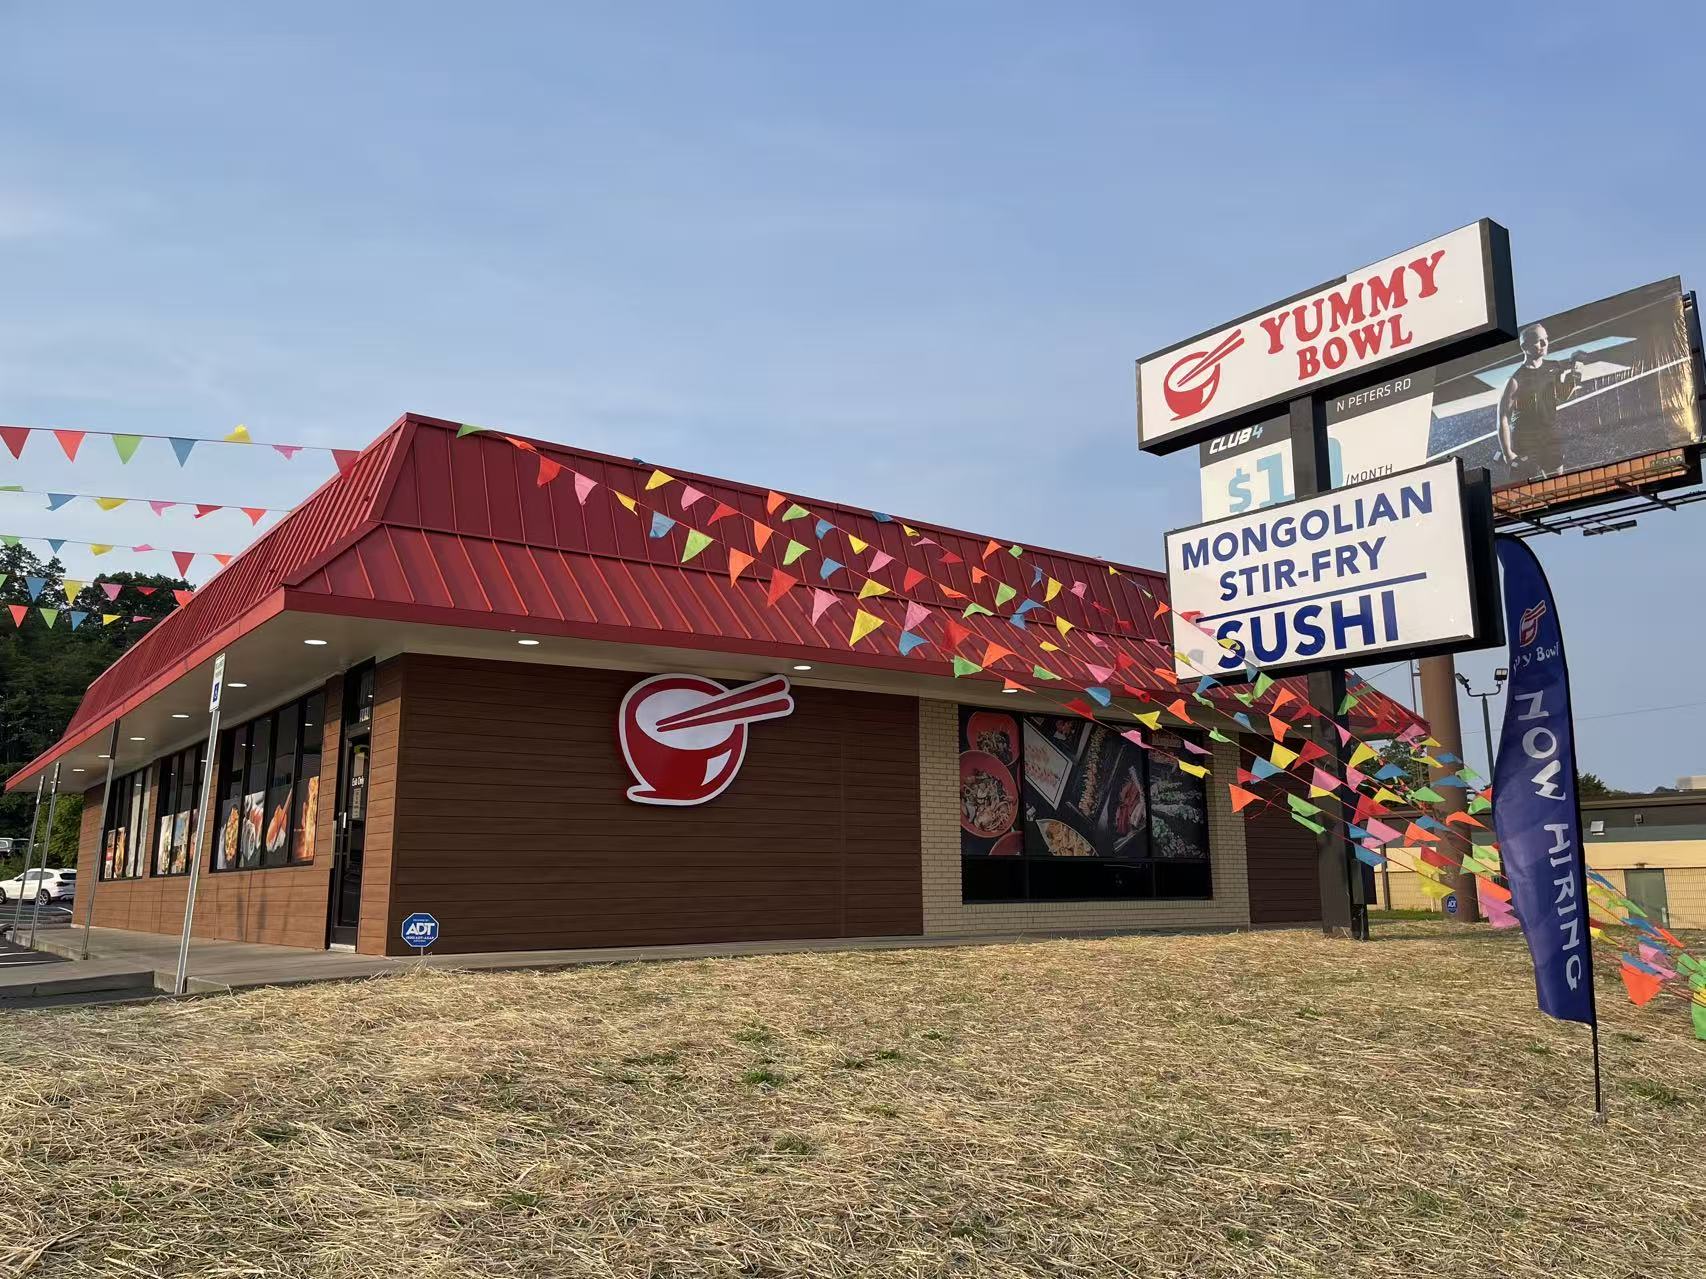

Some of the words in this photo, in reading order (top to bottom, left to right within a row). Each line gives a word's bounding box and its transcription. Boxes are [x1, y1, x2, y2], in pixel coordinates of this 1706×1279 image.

[1260, 250, 1446, 355] YUMMY
[1297, 314, 1413, 381] BOWL
[1336, 401, 1345, 413] N
[1348, 385, 1391, 409] PETERS
[1395, 378, 1412, 393] RD
[1181, 481, 1433, 571] MONGOLIAN
[1220, 536, 1387, 602] STIR-FRY
[1217, 589, 1399, 669] SUSHI
[1514, 689, 1567, 801] NOW
[1543, 823, 1583, 992] HIRING
[405, 922, 435, 936] ADT
